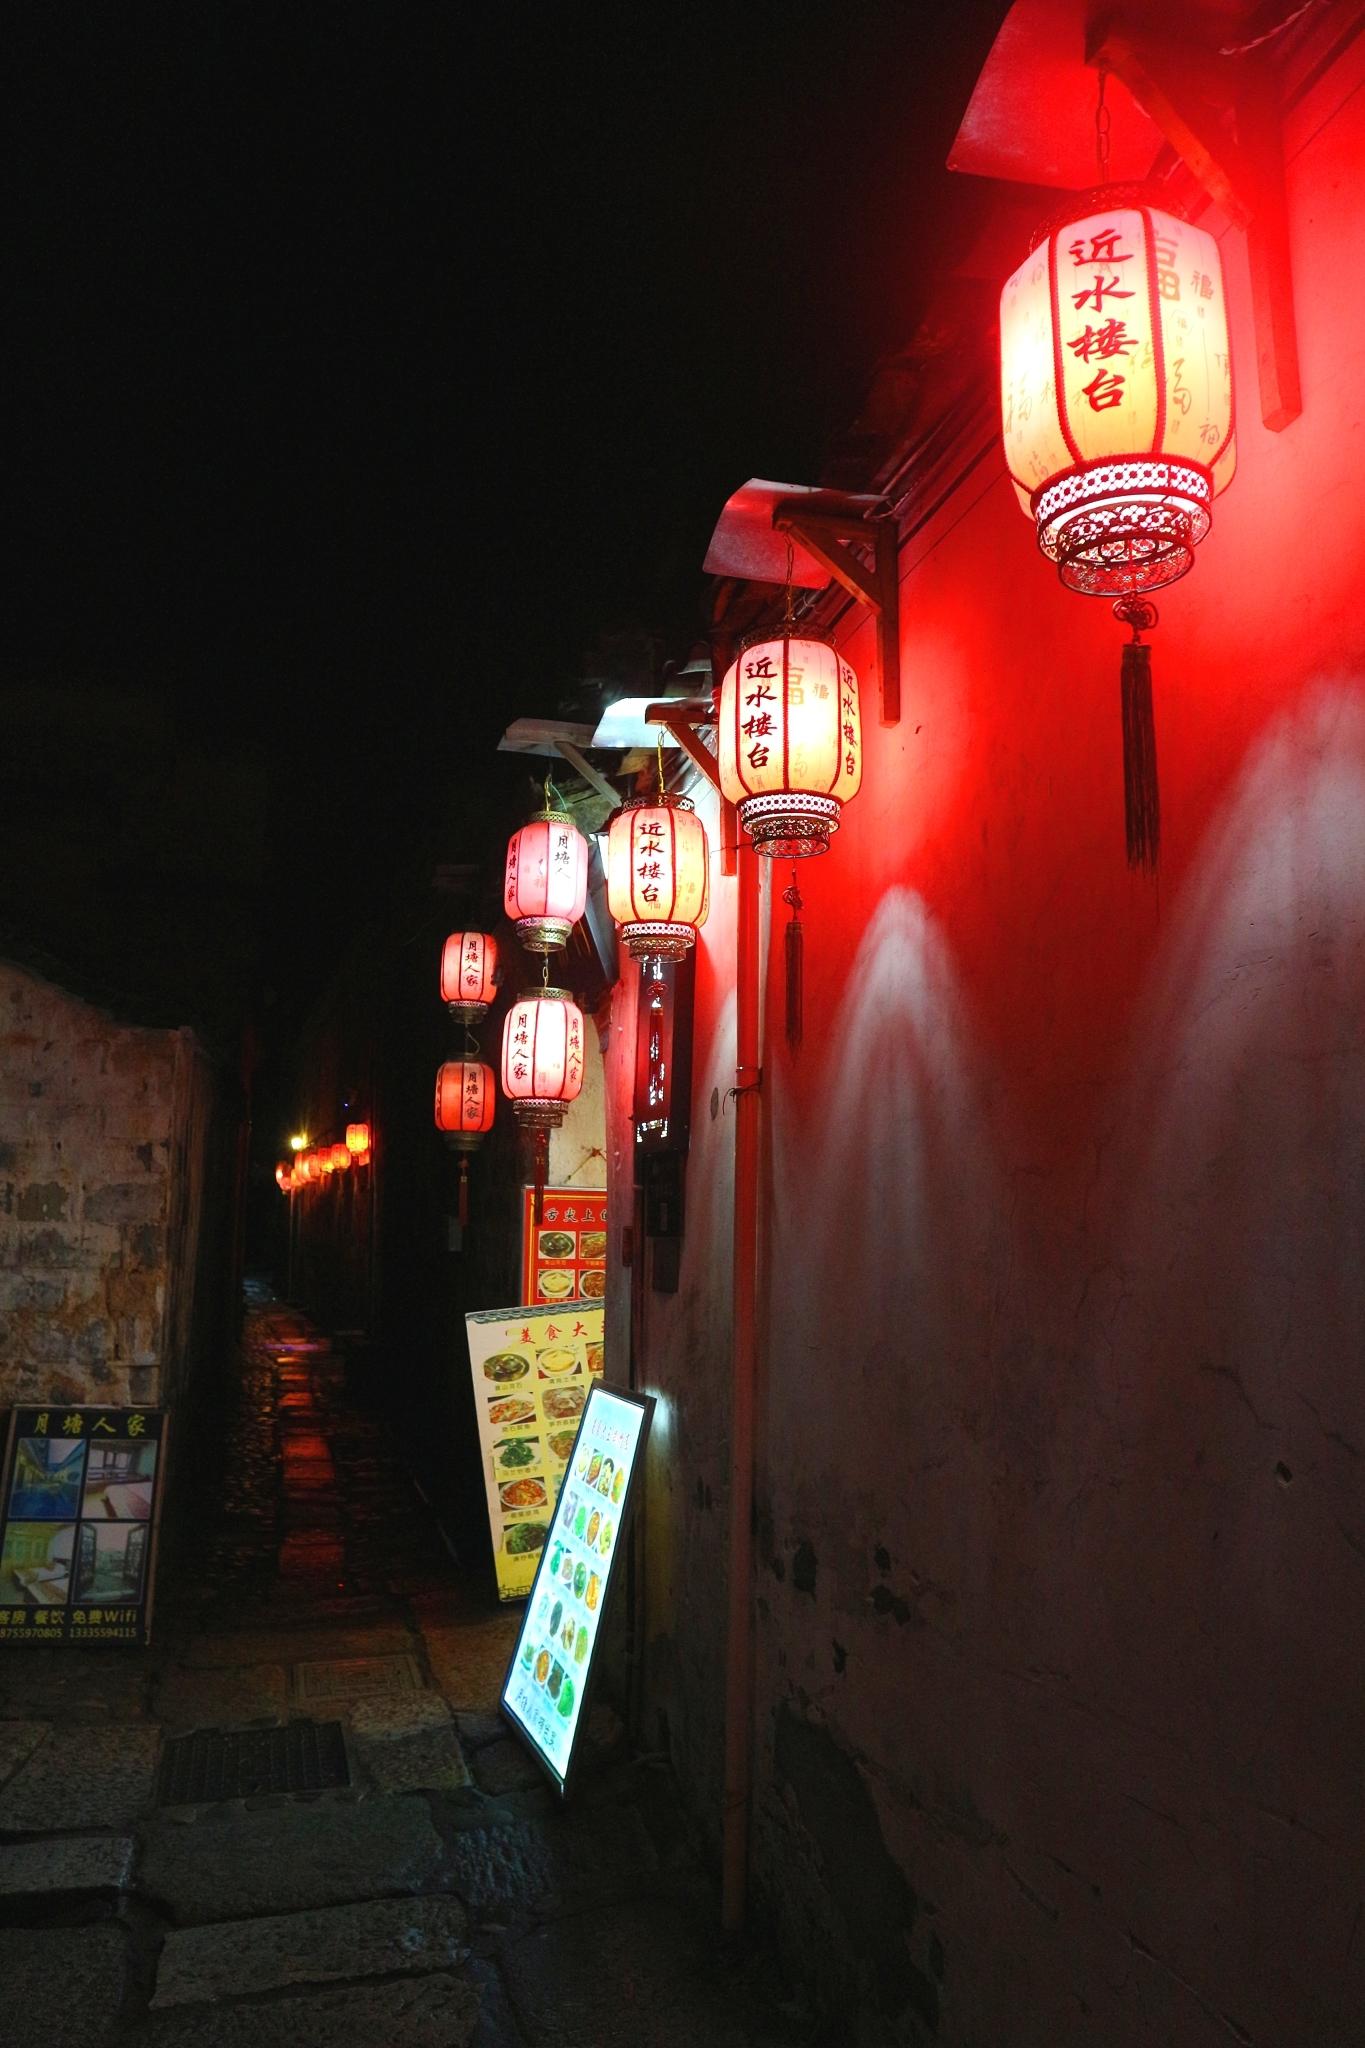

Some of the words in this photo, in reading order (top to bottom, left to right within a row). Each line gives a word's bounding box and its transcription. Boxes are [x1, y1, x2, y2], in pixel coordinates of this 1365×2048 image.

[1066, 228, 1139, 412] 近水楼台
[741, 656, 778, 768] 近水楼台
[842, 666, 858, 776] 近水楼台
[507, 838, 518, 902] 月塘人家
[637, 823, 666, 902] 近水楼台
[464, 939, 480, 986] 月塘人家
[511, 1013, 530, 1080] 月塘人家
[569, 1017, 581, 1082] 月塘人家
[465, 1072, 480, 1119] 月塘人家
[34, 1412, 146, 1437] 月塘人家
